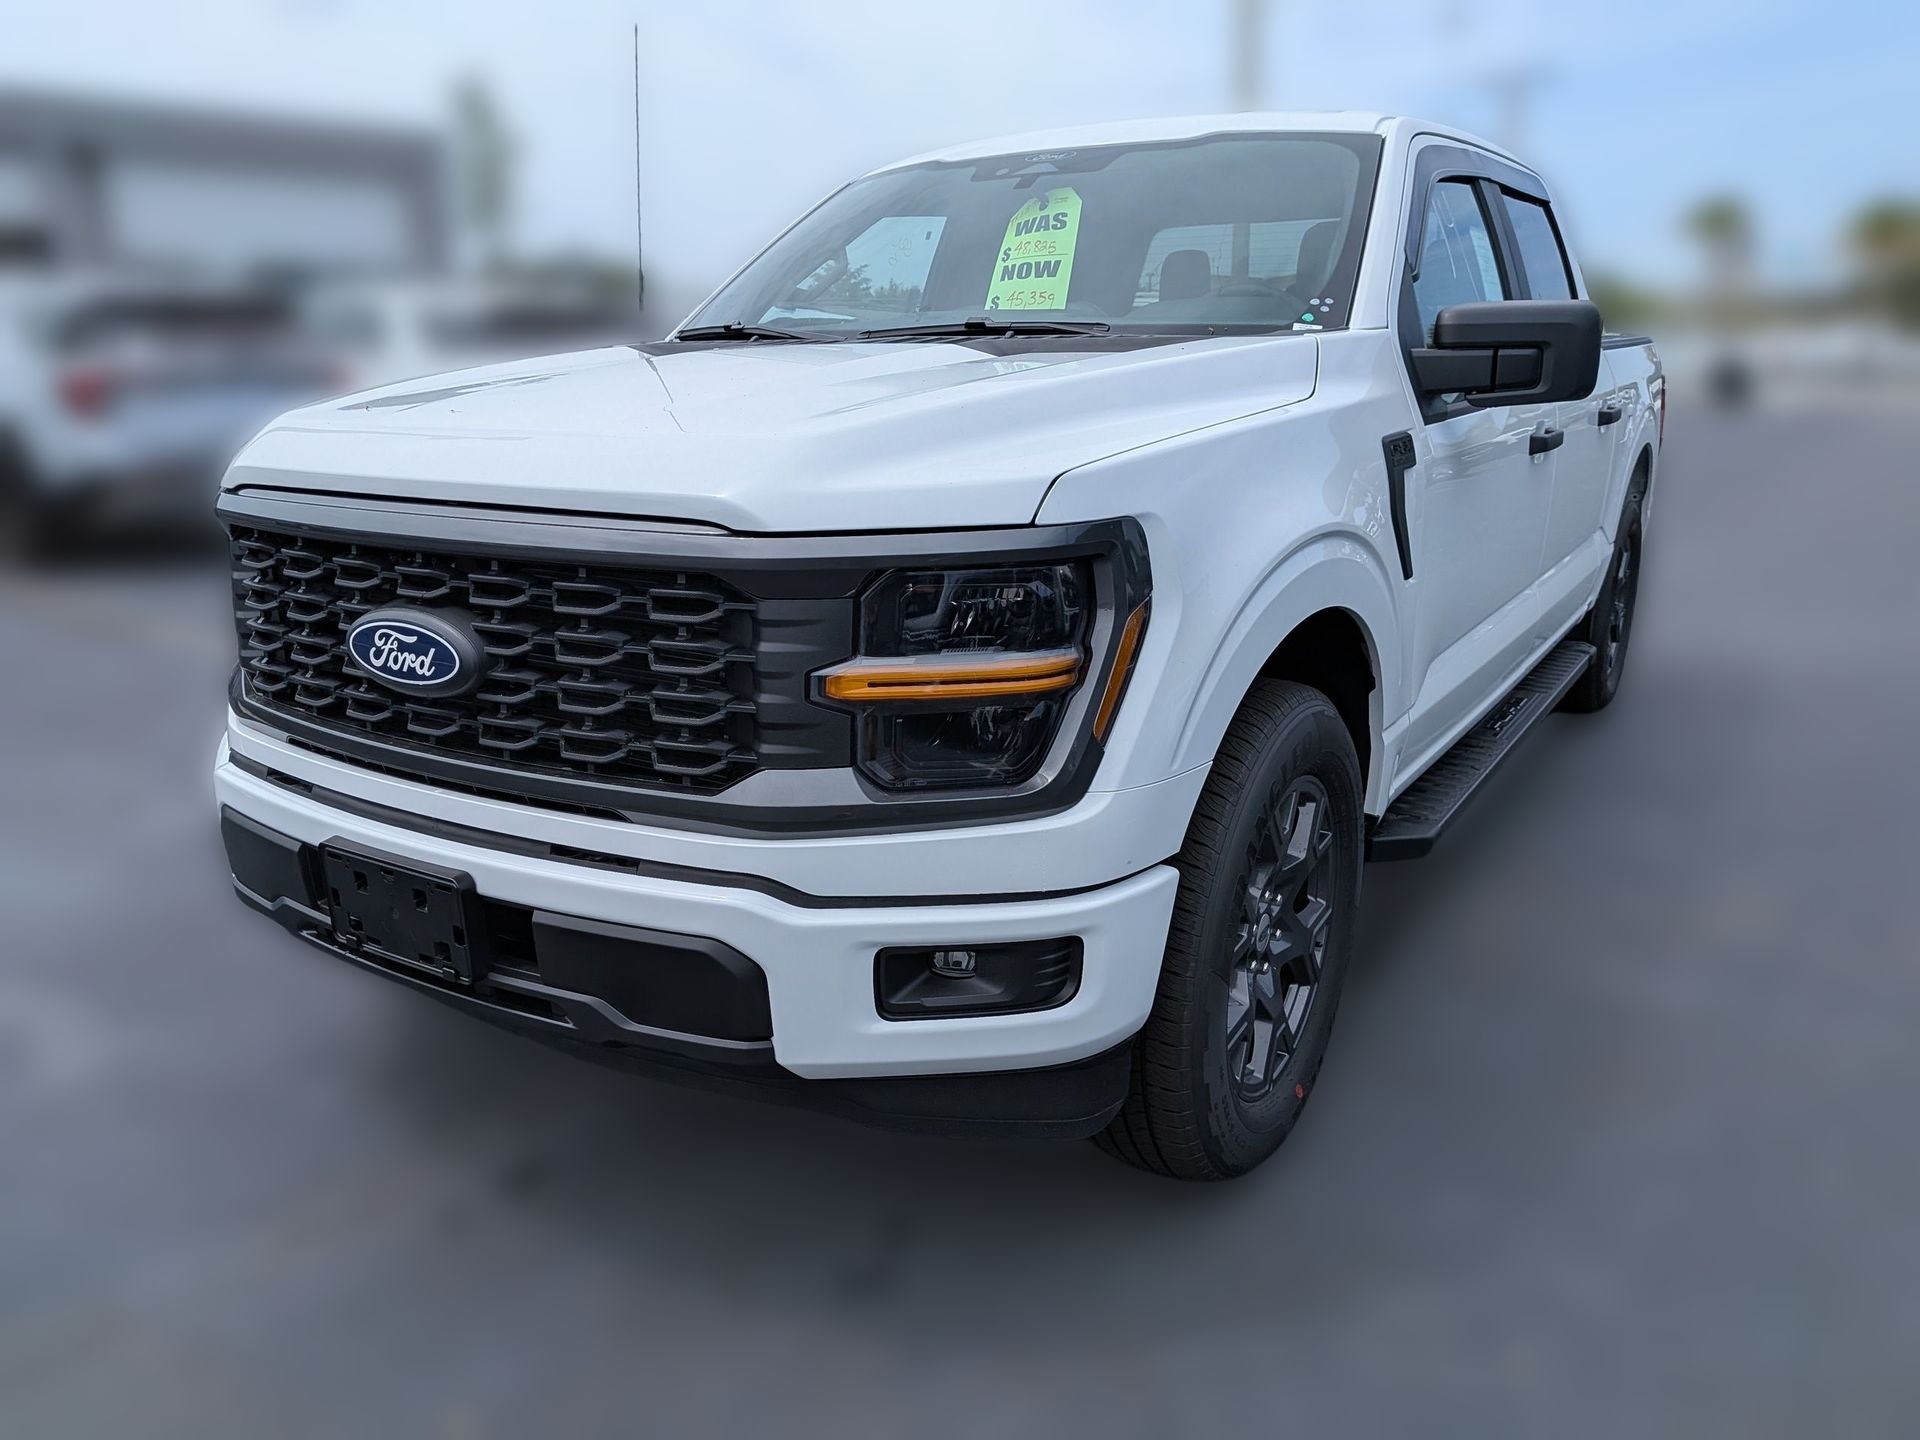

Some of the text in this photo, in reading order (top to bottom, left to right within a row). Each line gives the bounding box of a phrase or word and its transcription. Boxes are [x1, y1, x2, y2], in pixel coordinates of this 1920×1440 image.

[1014, 212, 1068, 237] WAS
[1001, 246, 1012, 263] $
[1000, 259, 1062, 282] NOW
[1006, 290, 1055, 310] 45,359
[369, 628, 436, 677] Ford
